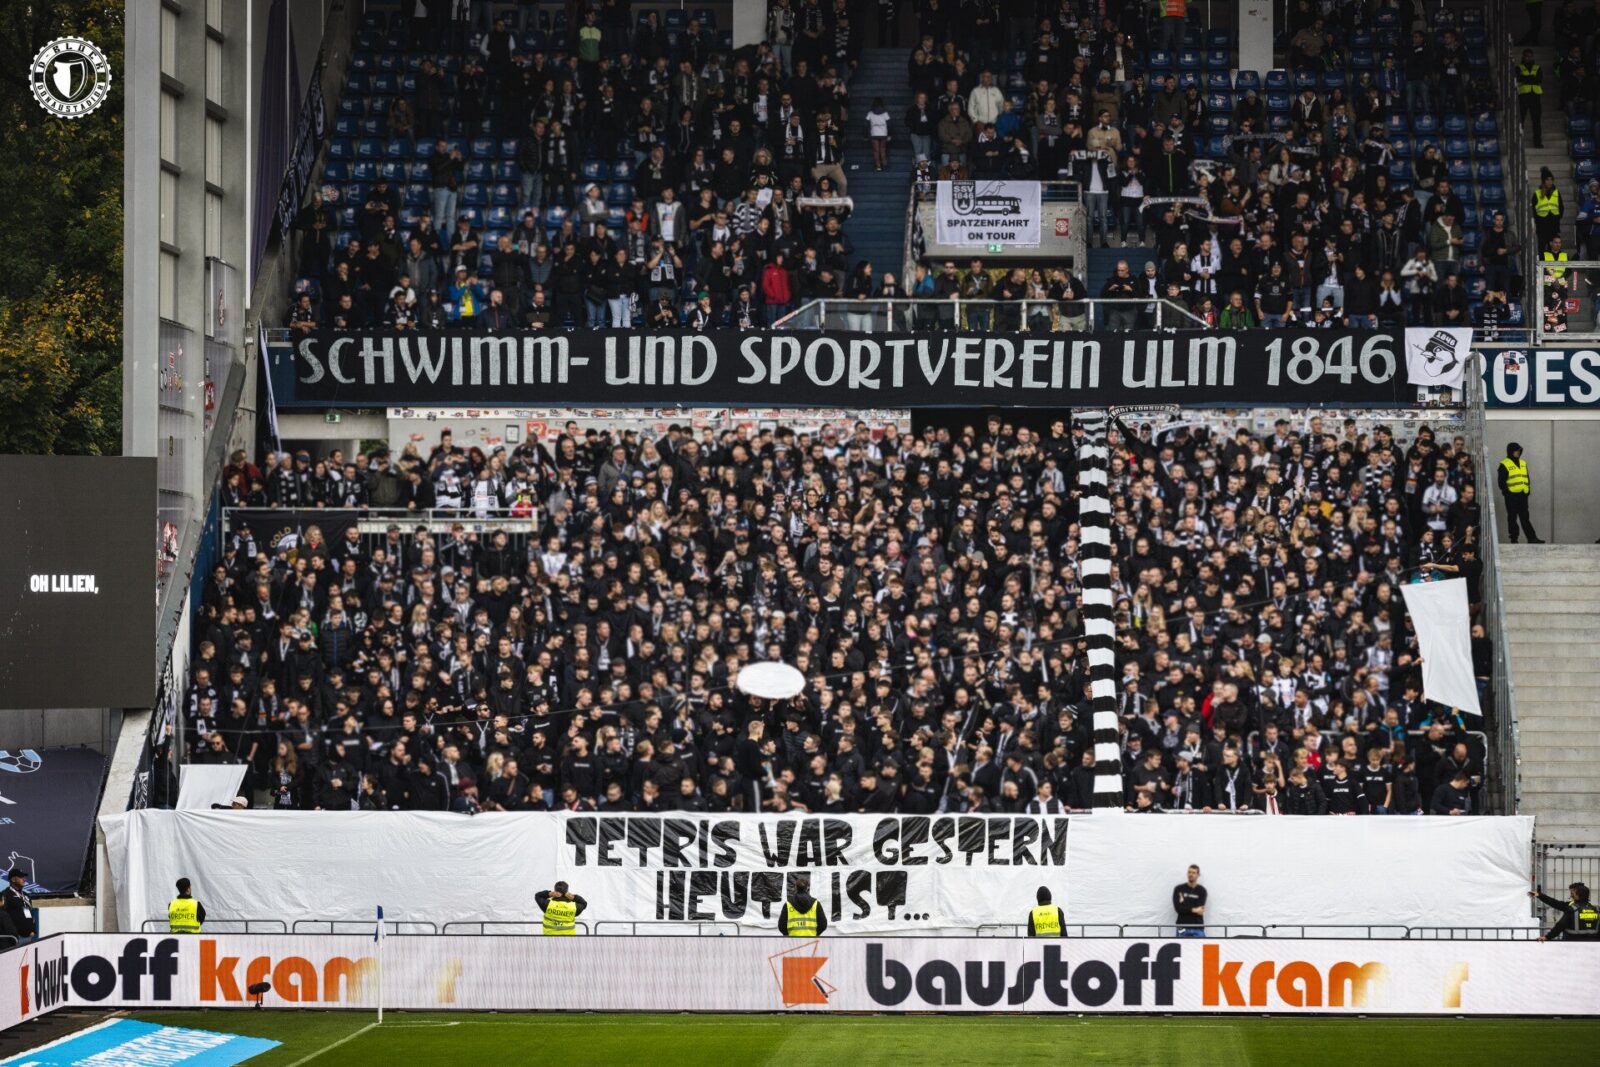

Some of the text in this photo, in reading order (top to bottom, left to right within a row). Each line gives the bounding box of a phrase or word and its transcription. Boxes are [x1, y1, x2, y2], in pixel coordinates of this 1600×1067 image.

[947, 219, 1030, 228] SPATZENFAHRT
[968, 232, 1016, 240] ON TOUR
[1435, 331, 1457, 347] 1846
[605, 335, 718, 386] UND
[737, 336, 1101, 390] SPORTVEREIN
[1122, 337, 1237, 389] ULM
[1265, 334, 1397, 387] 1846
[30, 575, 99, 595] OH LILIEN,
[566, 816, 1069, 868] TETRIS WAR GESTERN
[865, 942, 1182, 1008] baustoff
